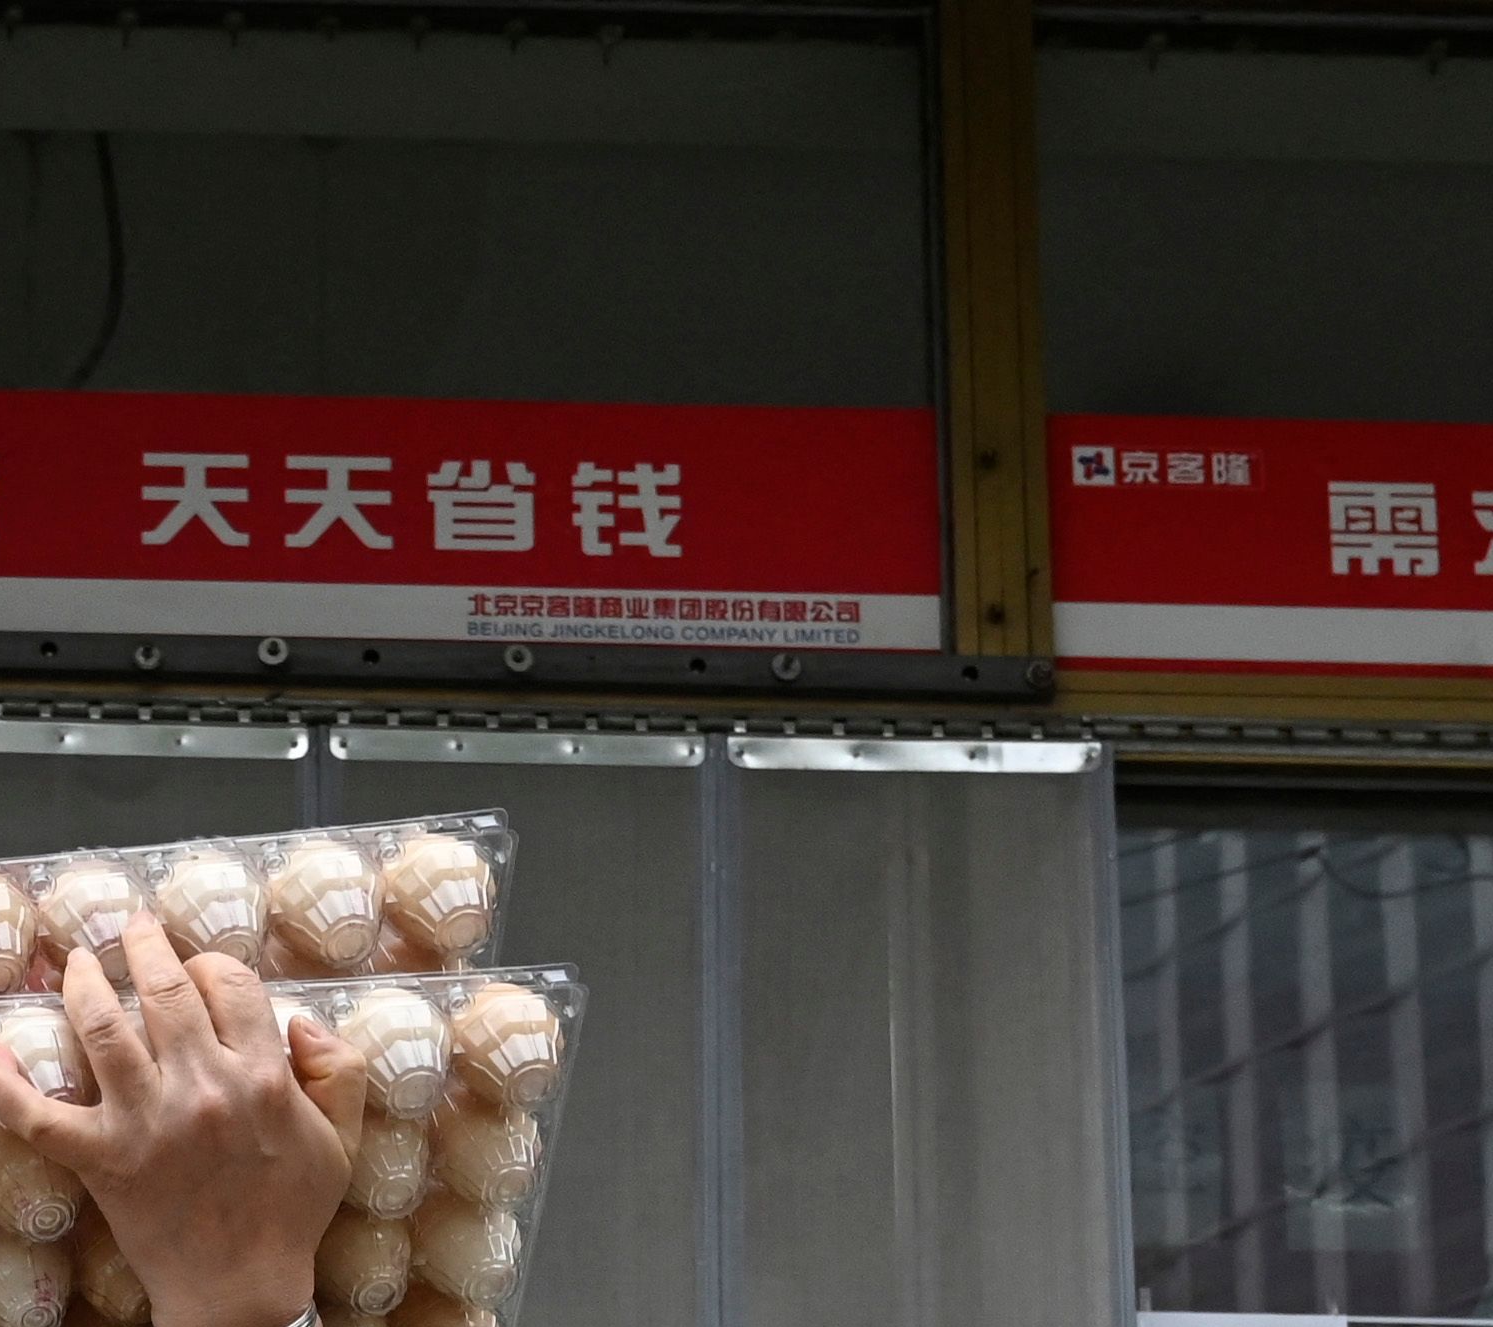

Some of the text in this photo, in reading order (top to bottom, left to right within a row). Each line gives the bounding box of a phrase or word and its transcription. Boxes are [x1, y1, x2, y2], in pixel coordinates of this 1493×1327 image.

[1120, 450, 1251, 486] 京客隆
[140, 451, 684, 558] 天天省钱
[467, 593, 861, 623] 北京京客隆商业集团股份有限公司
[467, 621, 861, 646] BEIJING JINGKELONG COMPANY LIMITED
